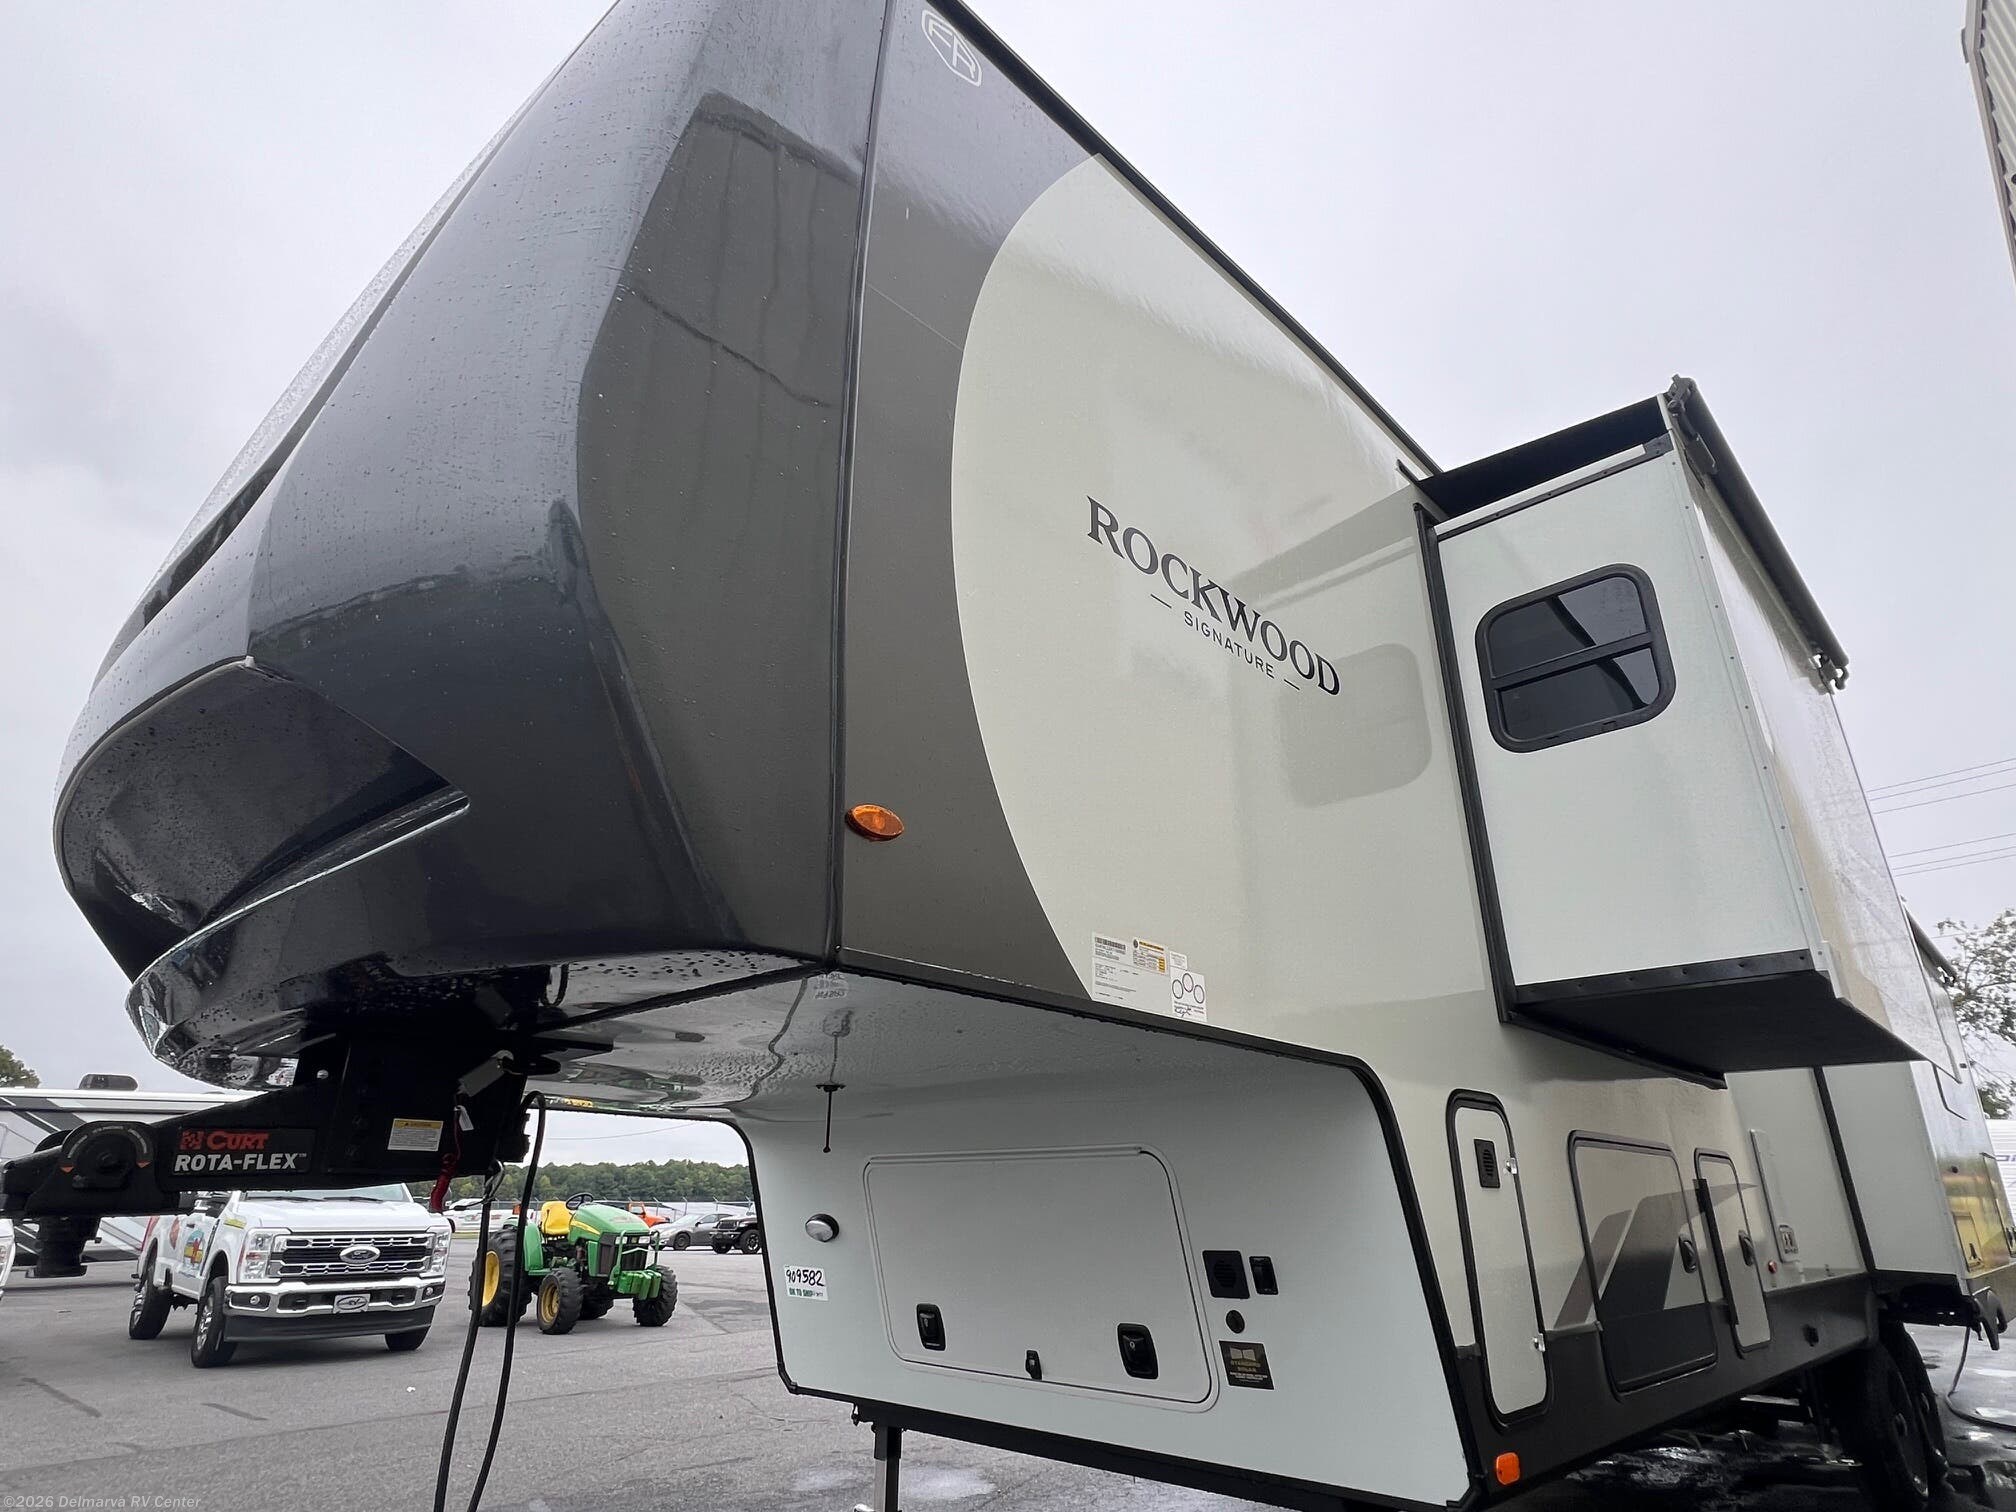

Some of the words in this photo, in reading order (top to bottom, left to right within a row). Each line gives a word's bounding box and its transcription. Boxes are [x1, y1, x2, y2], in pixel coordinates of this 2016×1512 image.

[1087, 495, 1340, 696] ROCKWOOD
[1184, 611, 1275, 679] SIGNATURE
[206, 1130, 269, 1151] CURT
[785, 1268, 825, 1287] 909582
